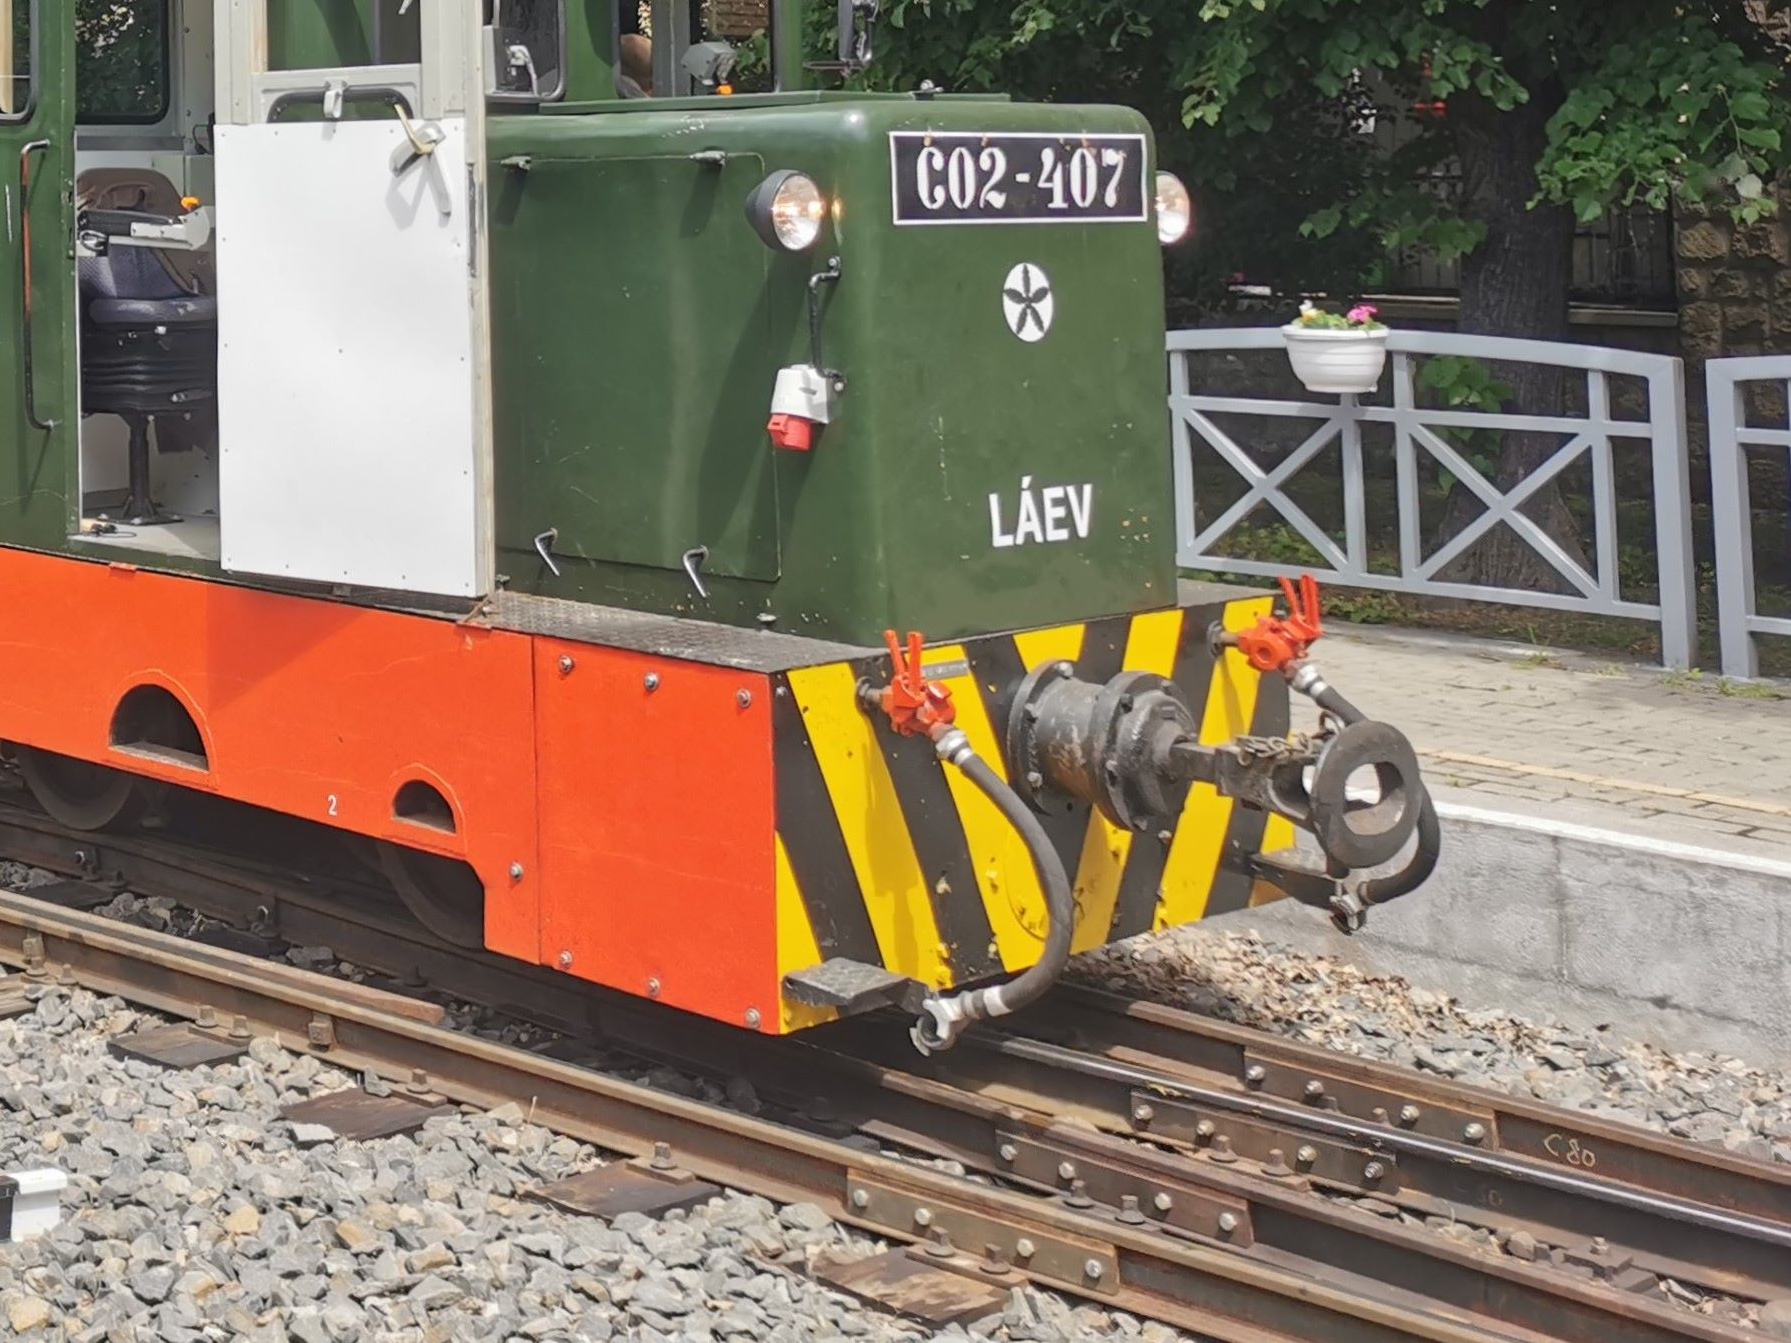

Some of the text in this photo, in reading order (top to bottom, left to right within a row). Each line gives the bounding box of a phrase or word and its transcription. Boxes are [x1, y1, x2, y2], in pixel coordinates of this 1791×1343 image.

[916, 146, 1127, 210] C02-407
[988, 475, 1092, 548] LÁEV
[327, 794, 338, 816] 2
